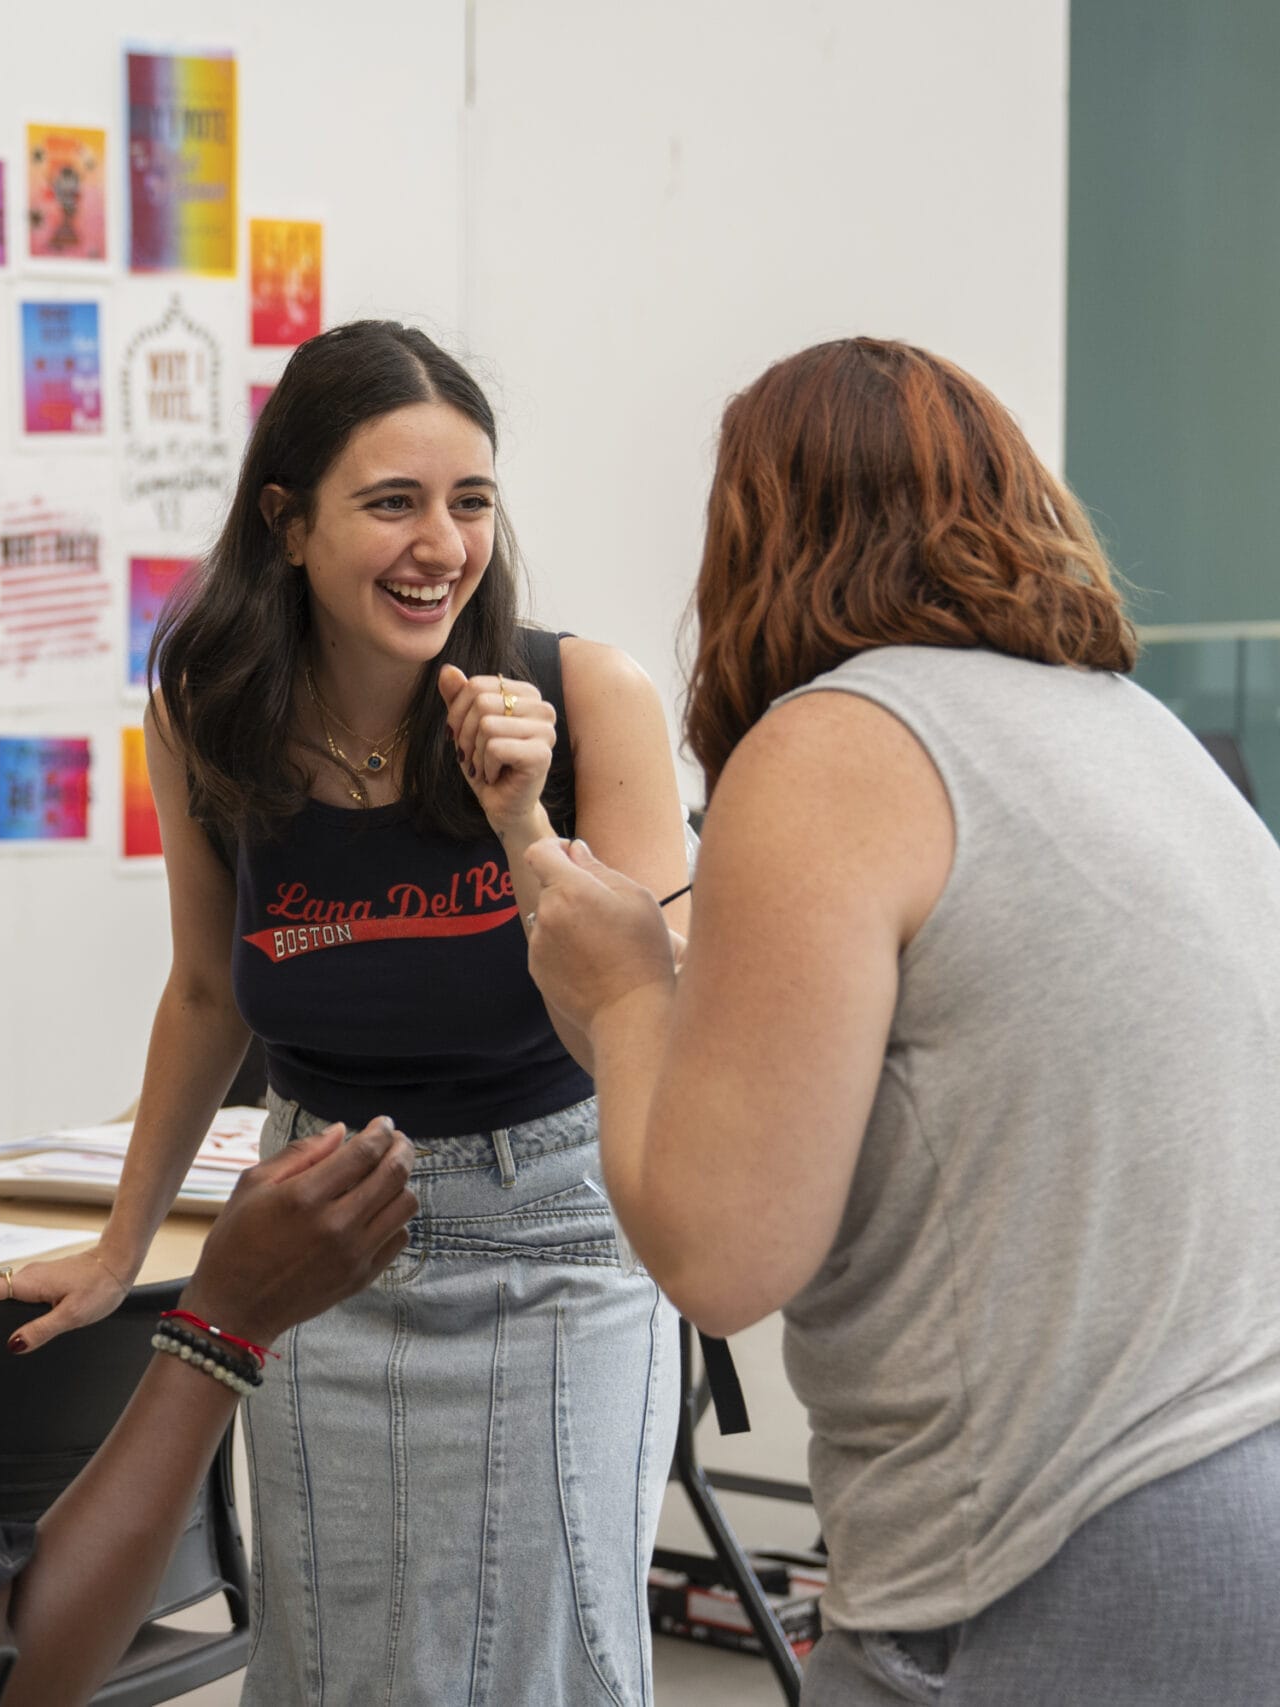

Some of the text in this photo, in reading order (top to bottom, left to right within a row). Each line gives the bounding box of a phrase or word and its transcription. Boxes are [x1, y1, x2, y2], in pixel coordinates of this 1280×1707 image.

[267, 861, 514, 924] Lana Del Re
[274, 924, 352, 958] BOSTON
